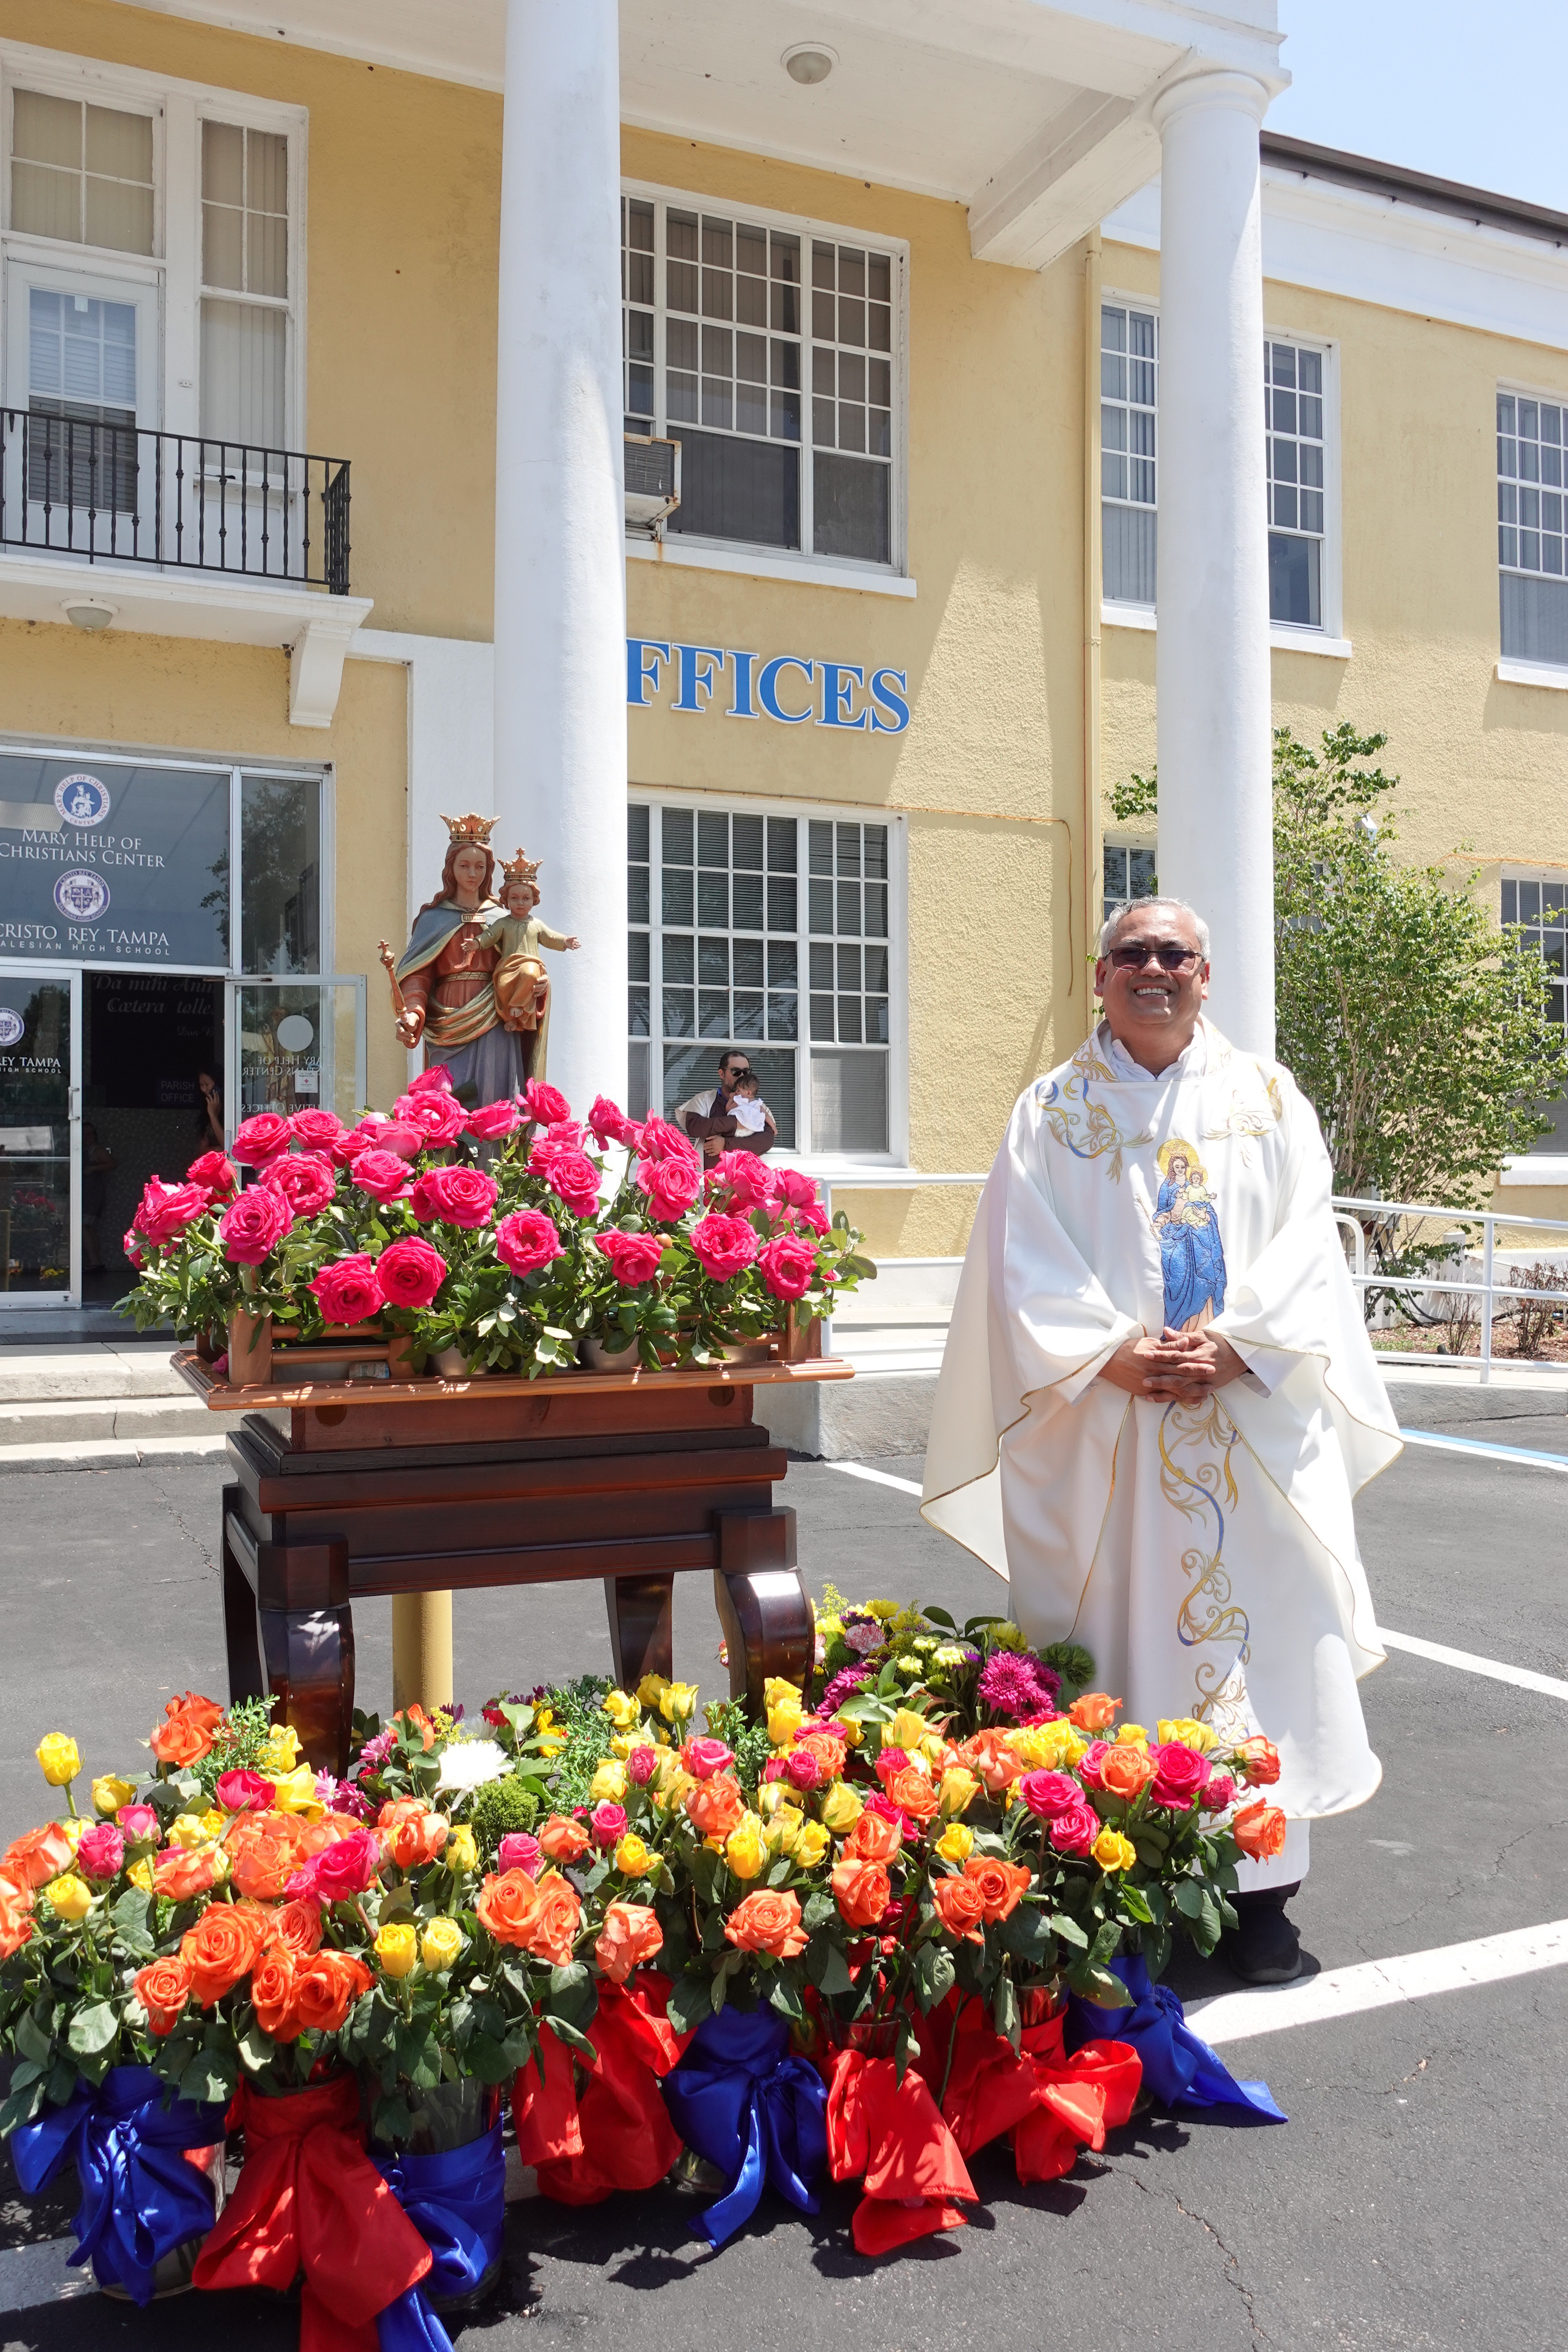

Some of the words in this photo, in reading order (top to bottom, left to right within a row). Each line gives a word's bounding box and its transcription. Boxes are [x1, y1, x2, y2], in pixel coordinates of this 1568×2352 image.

[626, 637, 911, 735] FFICES
[59, 777, 74, 792] HELP
[56, 793, 67, 815] MARY
[89, 778, 108, 818] CHRISTIANS
[22, 829, 69, 845] MARY
[75, 832, 115, 848] HELP
[121, 837, 141, 850] OF
[0, 842, 96, 863] CHRISTIANS
[102, 850, 166, 867] CENTER
[68, 927, 100, 942] REY
[106, 929, 170, 946] TAMPA
[0, 940, 61, 950] ALESIAN
[116, 946, 170, 956] SCHOOL
[19, 1057, 61, 1067] TAMPA
[161, 1081, 194, 1090] PARISH
[161, 1093, 194, 1102] OFFICE
